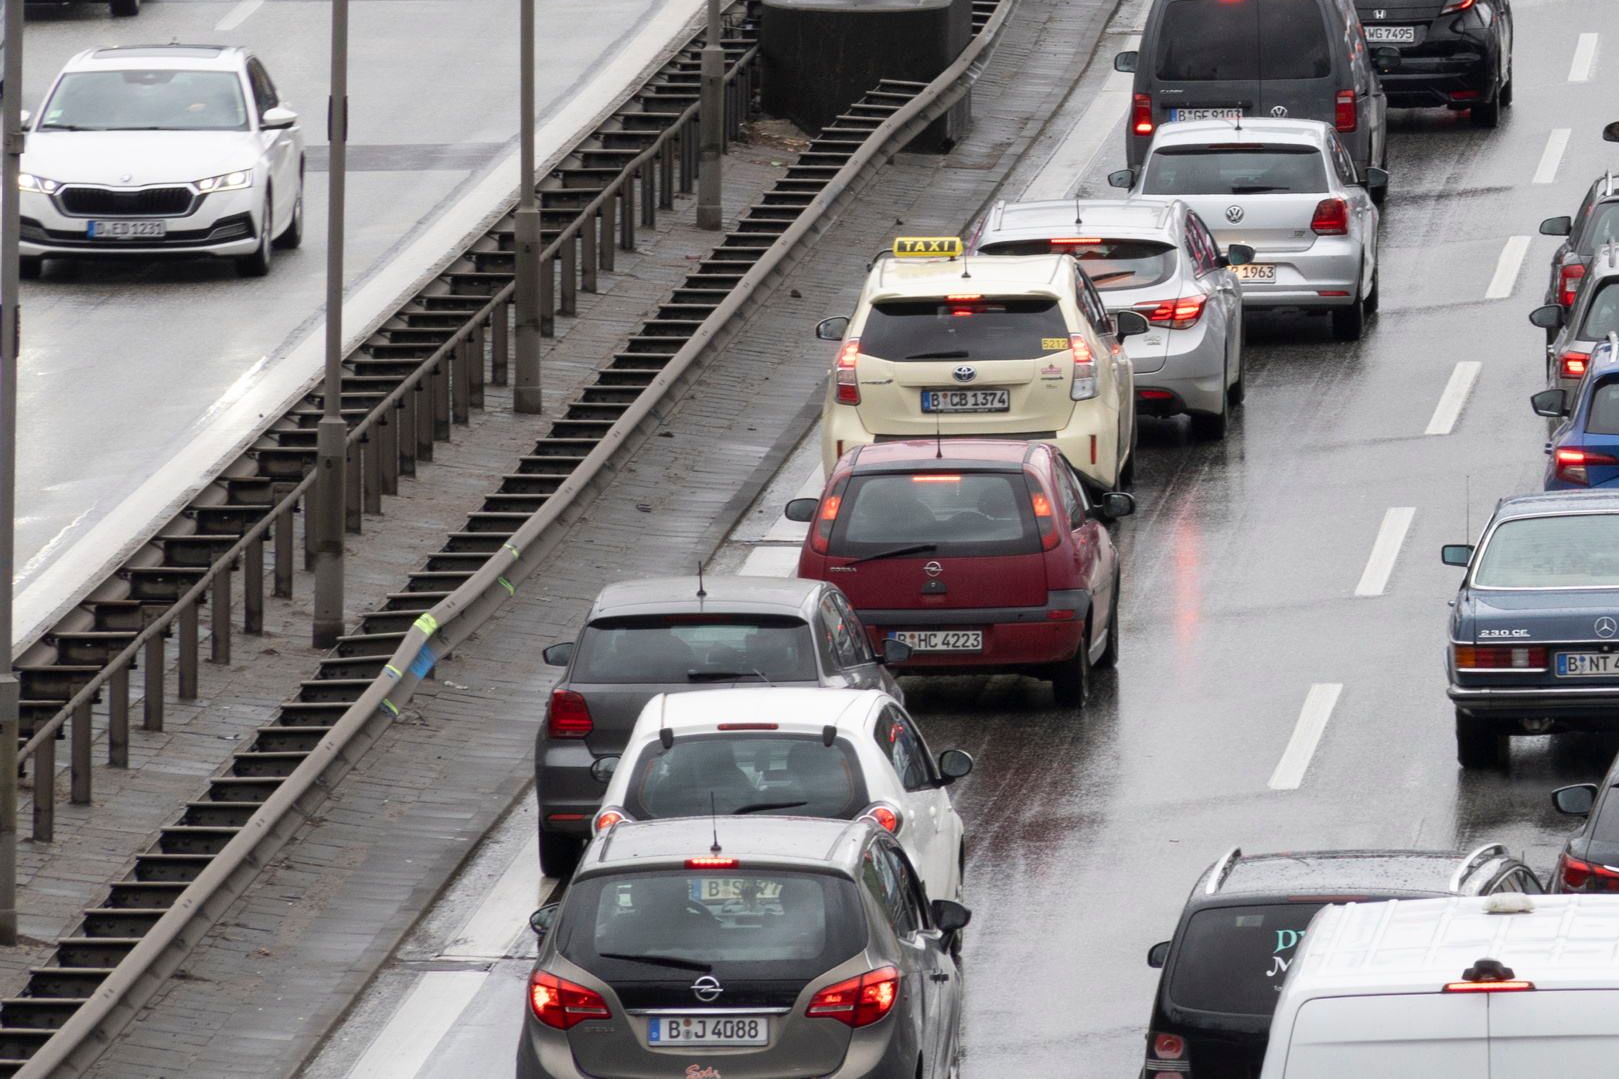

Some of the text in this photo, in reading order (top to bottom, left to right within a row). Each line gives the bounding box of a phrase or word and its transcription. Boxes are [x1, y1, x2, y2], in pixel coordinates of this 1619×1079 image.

[1385, 26, 1413, 39] 7495
[1179, 109, 1186, 121] B
[97, 221, 105, 236] D
[131, 221, 163, 236] 1231
[904, 240, 949, 252] TAXI
[1242, 266, 1274, 279] 1963
[1042, 339, 1067, 349] 5212
[931, 391, 1007, 407] B CB 1374
[919, 633, 938, 649] HC
[941, 633, 981, 649] 4223
[1567, 655, 1576, 671] B
[1589, 655, 1611, 671] NT
[668, 1020, 759, 1039] B J 4088
